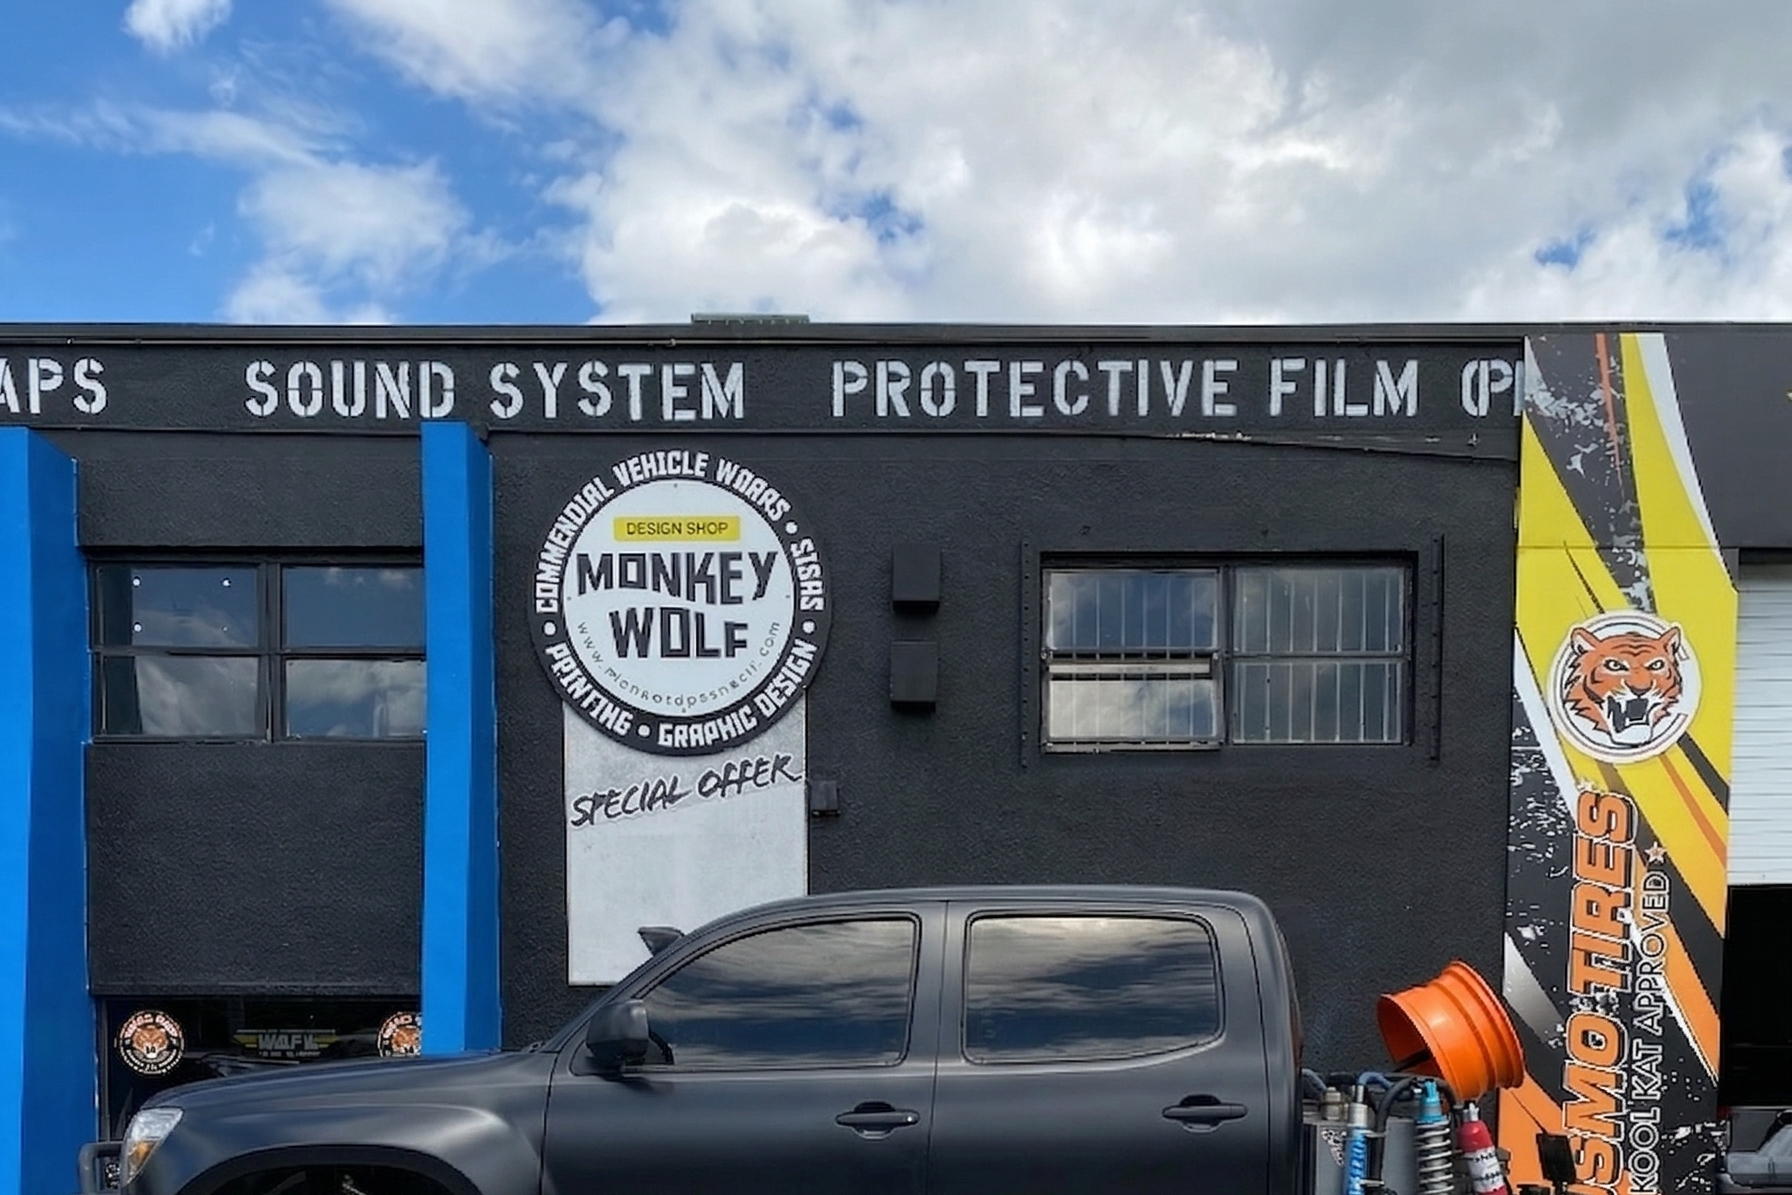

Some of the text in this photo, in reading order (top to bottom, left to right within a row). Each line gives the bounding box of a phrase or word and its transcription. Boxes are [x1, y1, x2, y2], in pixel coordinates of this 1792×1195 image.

[245, 361, 745, 421] SOUND SYSTEM
[832, 359, 1239, 417] PROTECTIVE
[1269, 358, 1418, 417] FILM
[612, 451, 710, 487] VEHICLE
[626, 522, 729, 535] DESIGN SHOP
[576, 551, 778, 605] MONKEY
[608, 607, 749, 659] WOLF
[657, 639, 818, 749] GRAPHIC DESIGN
[570, 753, 803, 827] SPECIAL OFFER
[1567, 788, 1639, 997] TIRES
[1627, 871, 1670, 1195] KOOL KAT APPROVED
